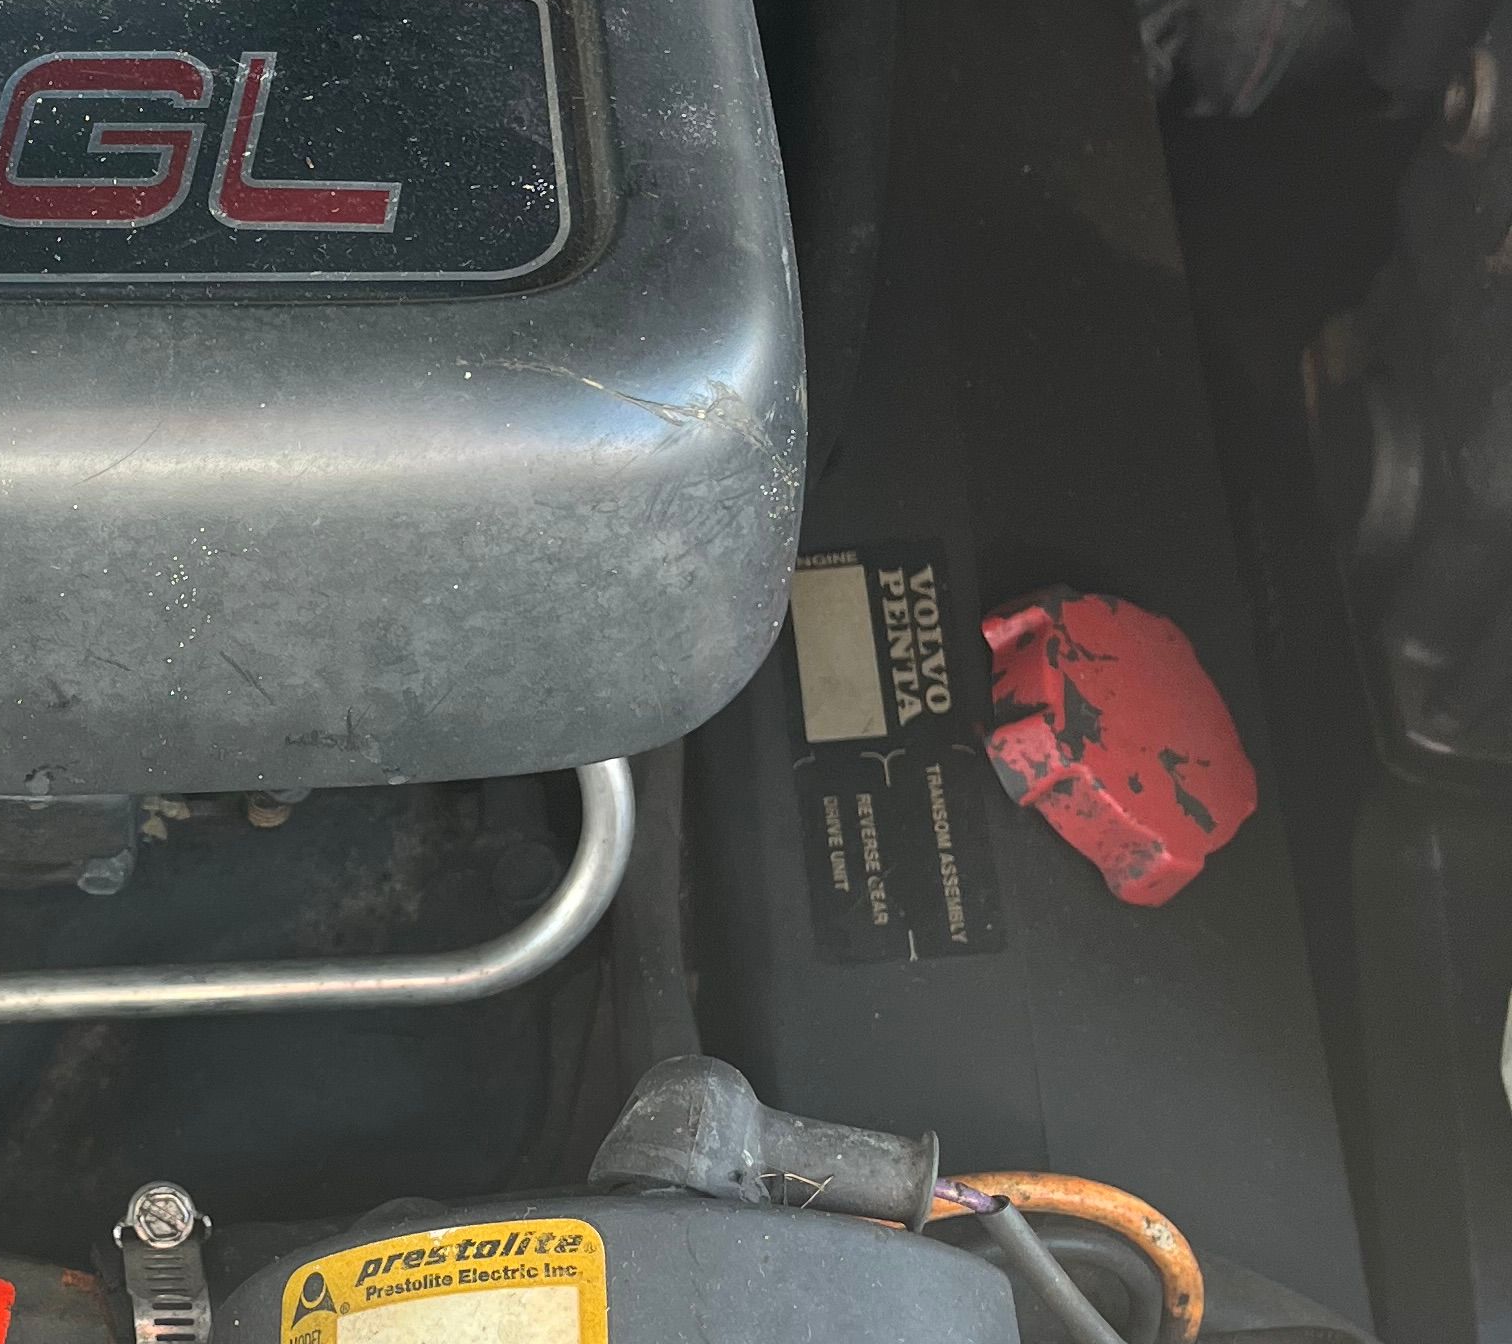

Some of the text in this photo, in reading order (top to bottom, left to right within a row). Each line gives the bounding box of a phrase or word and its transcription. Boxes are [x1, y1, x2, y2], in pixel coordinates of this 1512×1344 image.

[878, 567, 923, 726] PENTA
[908, 563, 952, 714] VOLVO
[823, 795, 850, 893] DRIVE UNIT
[855, 793, 888, 926] REVERSE GEAR
[925, 763, 968, 944] TRANSOM ASSEMBLY
[354, 1231, 585, 1288] prestolite
[364, 1272, 454, 1302] Prestolite
[457, 1262, 540, 1286] Electric
